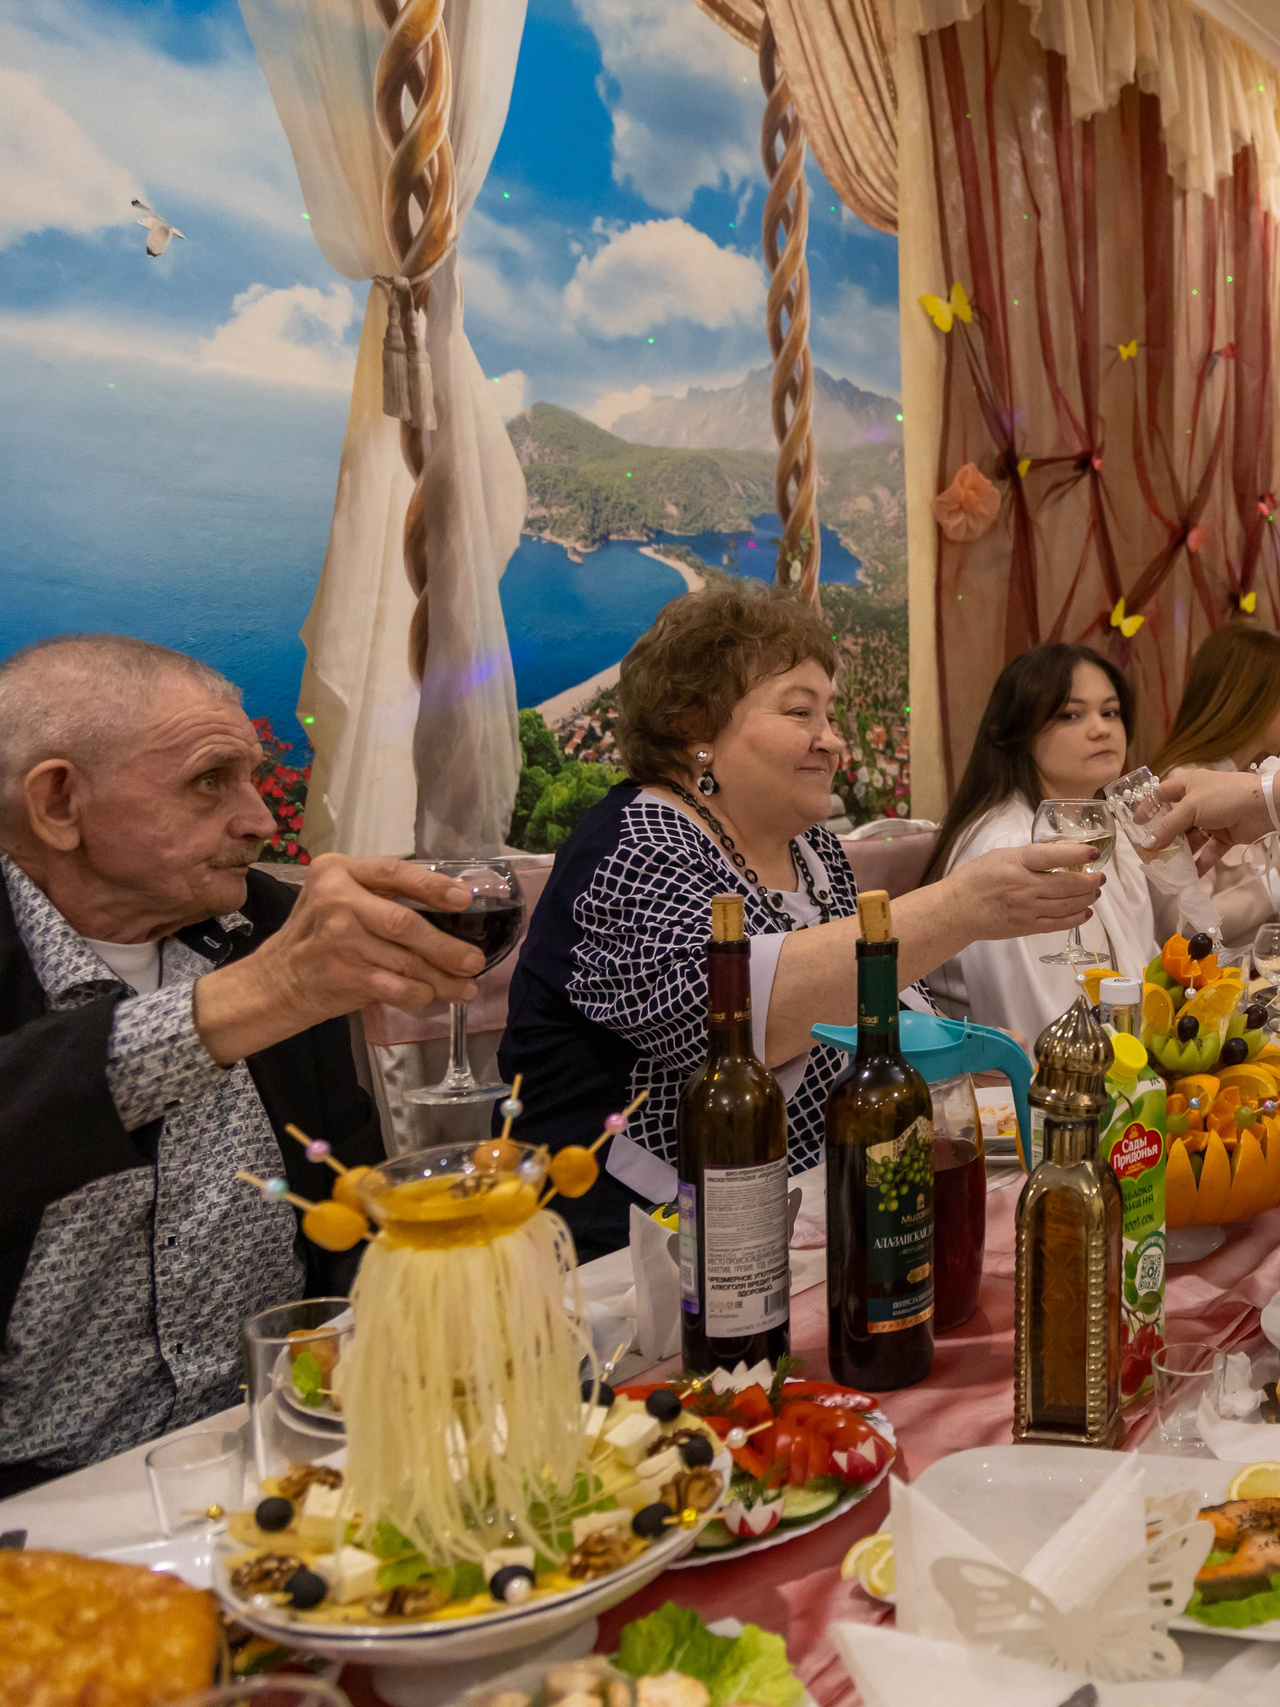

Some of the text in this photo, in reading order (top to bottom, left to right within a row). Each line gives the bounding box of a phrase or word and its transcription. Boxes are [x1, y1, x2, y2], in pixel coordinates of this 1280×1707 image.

[1121, 1136, 1148, 1154] Сады
[1113, 1144, 1158, 1170] Придонья
[874, 1227, 927, 1250] АЛАЗАНСКАЯ
[707, 1274, 753, 1283] ЧРЕЗМЕРНОЕ
[747, 1277, 771, 1289] ВРЕДИТ
